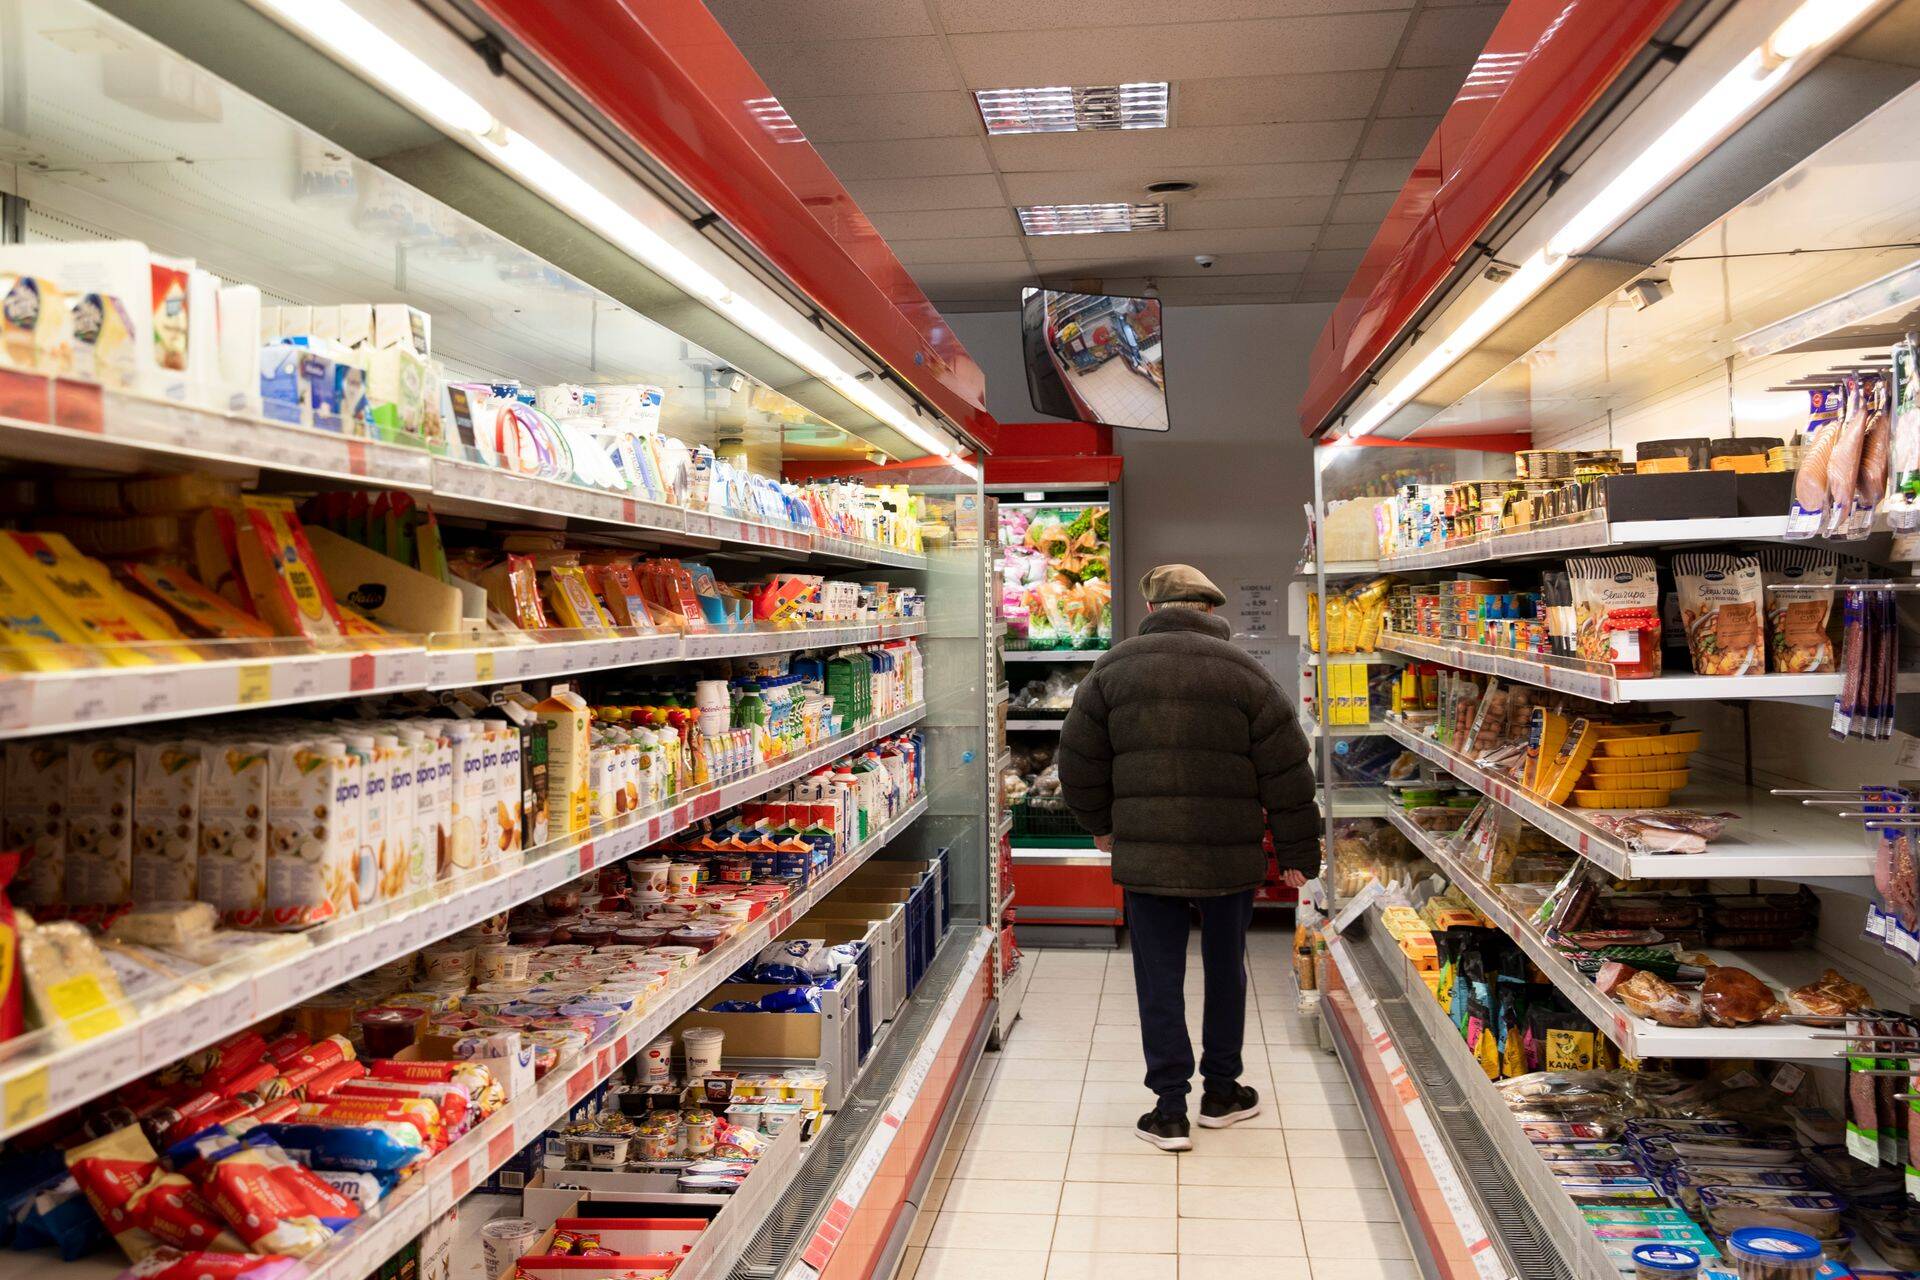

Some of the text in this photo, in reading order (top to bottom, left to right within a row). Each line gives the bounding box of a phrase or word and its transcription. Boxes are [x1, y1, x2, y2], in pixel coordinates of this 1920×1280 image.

[500, 749, 520, 768] alpro
[416, 766, 436, 788] alpro
[336, 781, 360, 807] alpro
